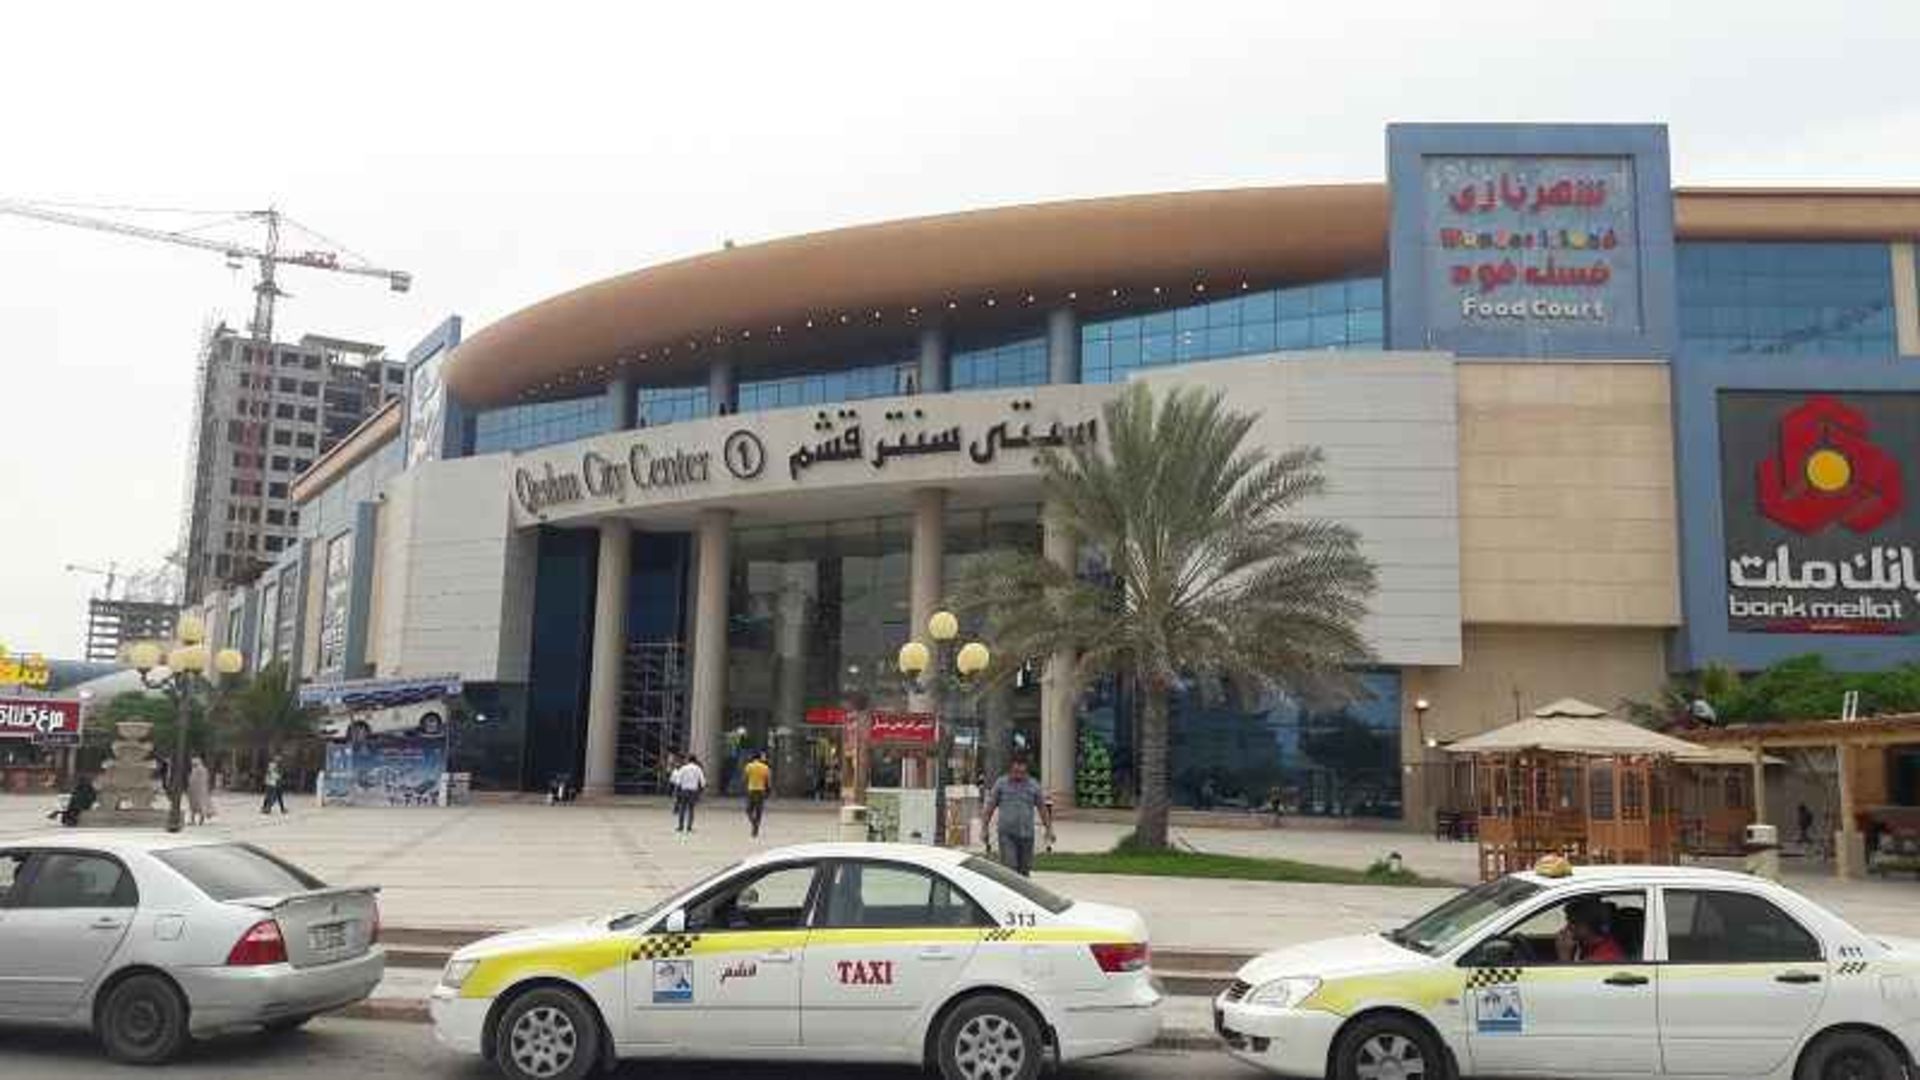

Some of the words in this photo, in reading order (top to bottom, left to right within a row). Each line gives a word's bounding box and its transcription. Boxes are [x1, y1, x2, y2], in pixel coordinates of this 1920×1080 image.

[1462, 297, 1528, 318] Food
[1533, 299, 1604, 319] Court
[789, 409, 862, 480] قشم
[871, 408, 961, 469] سنتر
[583, 451, 628, 504] City
[629, 443, 710, 490] Center
[1730, 545, 1836, 589] ملت
[1729, 595, 1806, 617] bank
[1810, 597, 1902, 618] mellat
[1004, 911, 1035, 927] 313
[837, 961, 892, 984] TAXI
